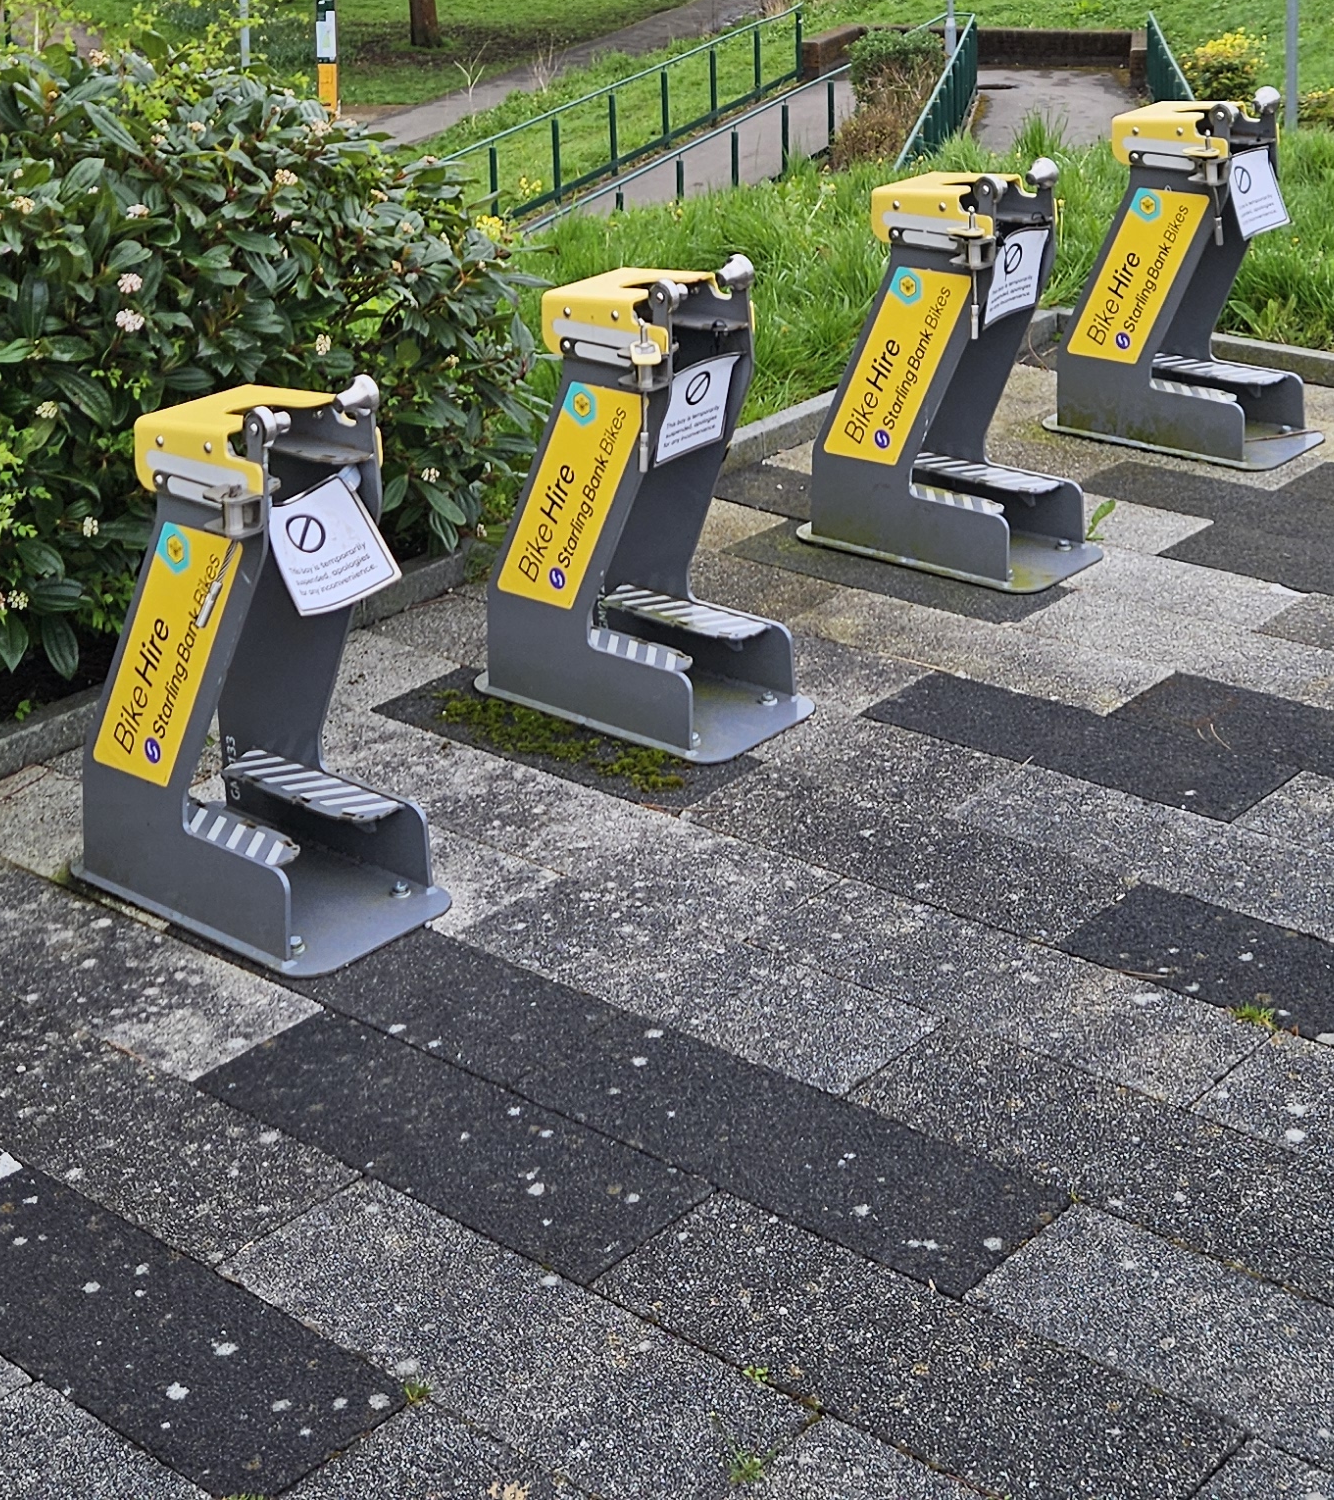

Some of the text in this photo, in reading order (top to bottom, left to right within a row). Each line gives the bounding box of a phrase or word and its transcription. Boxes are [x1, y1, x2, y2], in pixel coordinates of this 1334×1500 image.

[1087, 252, 1140, 346] Bike Hire
[1123, 204, 1189, 333] Starling Bank Bikes
[844, 339, 900, 444] Bike Hire
[882, 286, 951, 431] Starling Bank Bikes
[518, 463, 576, 583] Bike Hire
[557, 406, 627, 569] Starling Bank Bikes
[320, 541, 367, 569] temporarily
[331, 553, 371, 577] apologies
[113, 617, 169, 755] Bike Hire
[152, 553, 221, 740] Starling Bank Bikes
